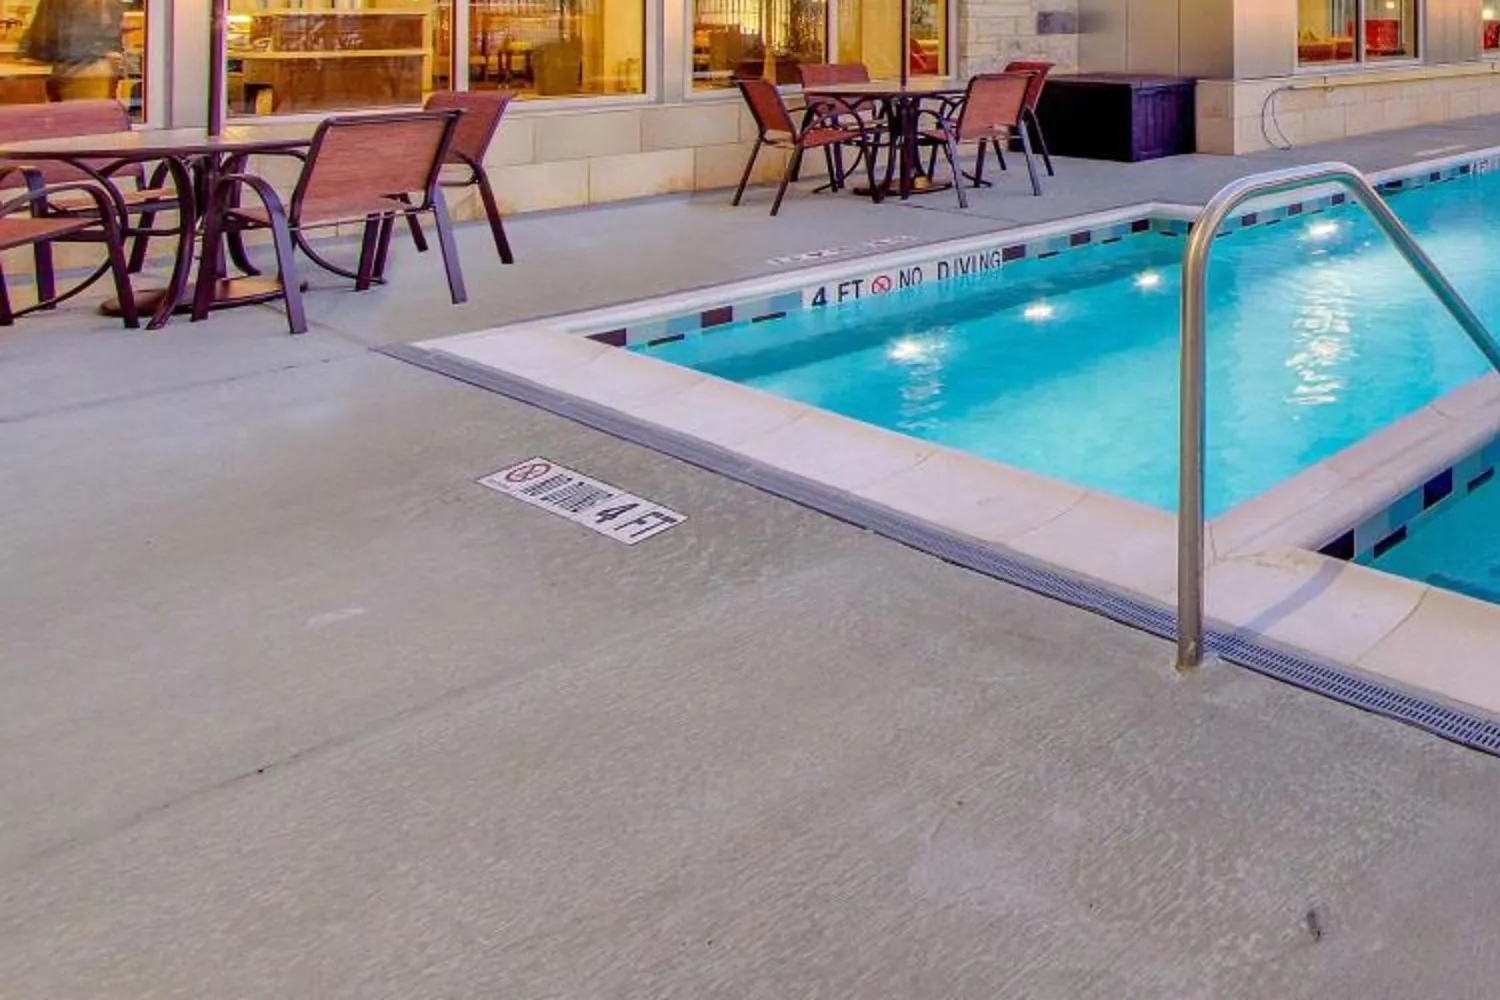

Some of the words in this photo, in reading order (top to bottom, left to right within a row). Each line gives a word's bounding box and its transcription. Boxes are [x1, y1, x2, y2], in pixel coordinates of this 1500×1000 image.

[811, 286, 828, 307] 4
[838, 279, 865, 302] FT
[899, 266, 923, 289] NO
[937, 251, 1001, 281] DIVING
[595, 502, 641, 524] 4
[613, 510, 678, 538] FT
